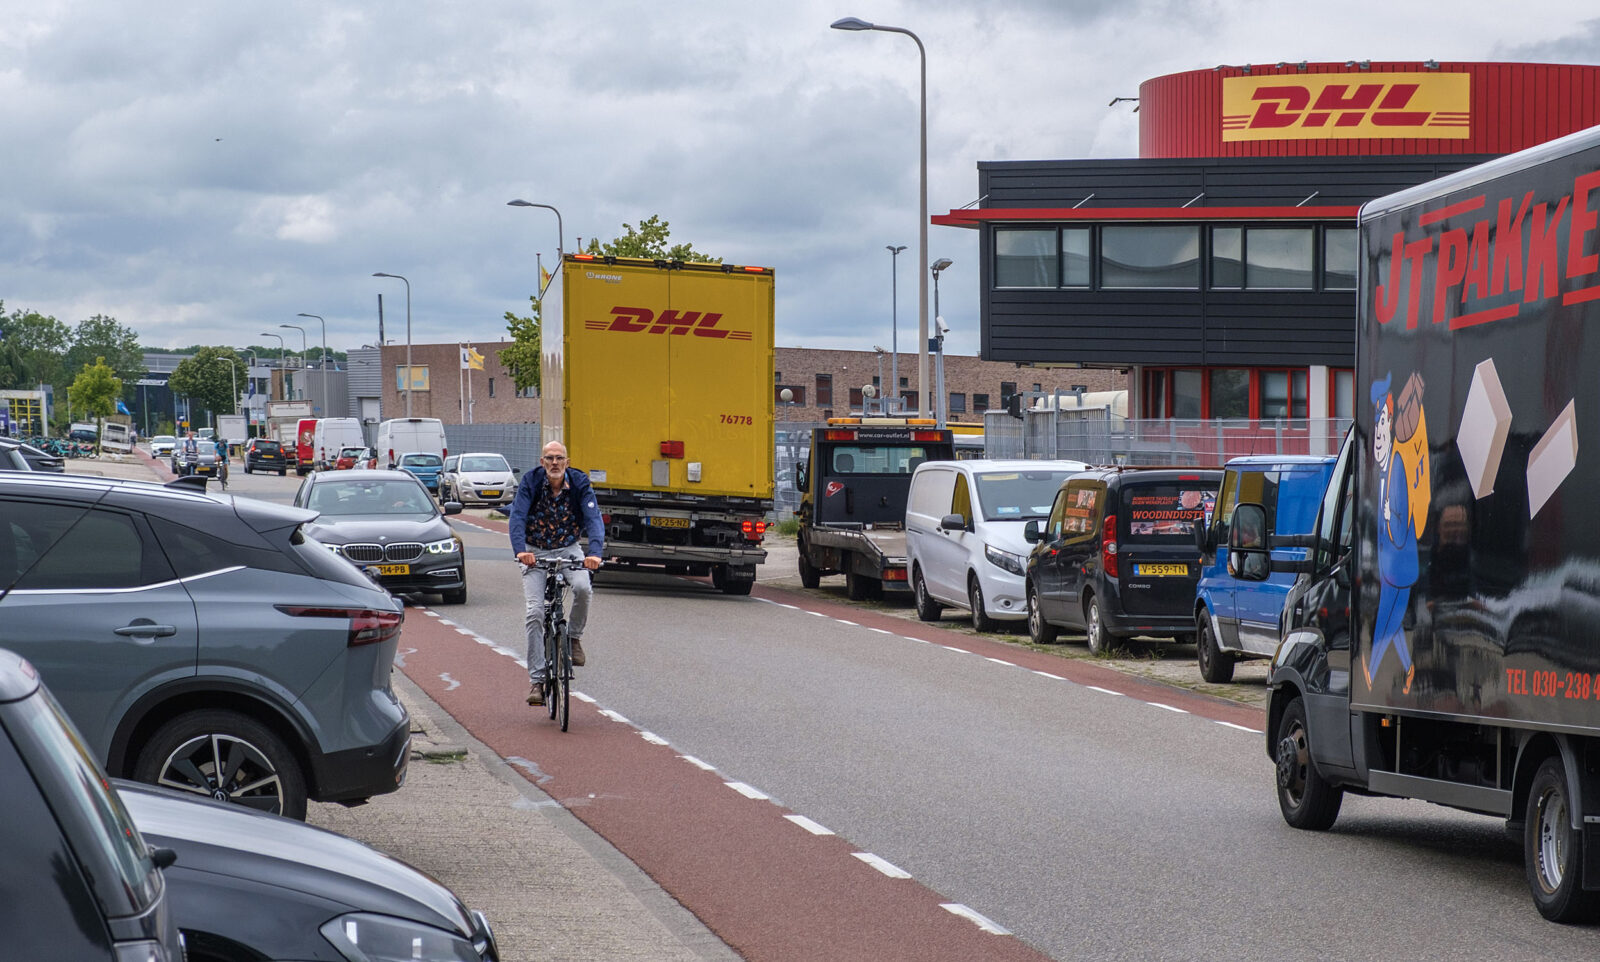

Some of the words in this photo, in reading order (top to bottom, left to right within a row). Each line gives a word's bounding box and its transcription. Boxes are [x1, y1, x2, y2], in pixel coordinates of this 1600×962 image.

[1247, 83, 1432, 129] DHL
[606, 305, 731, 339] DHL
[720, 414, 752, 426] 76778
[1142, 565, 1185, 574] V-559-TN
[1506, 668, 1529, 695] TEL
[1533, 670, 1591, 700] 030-238
